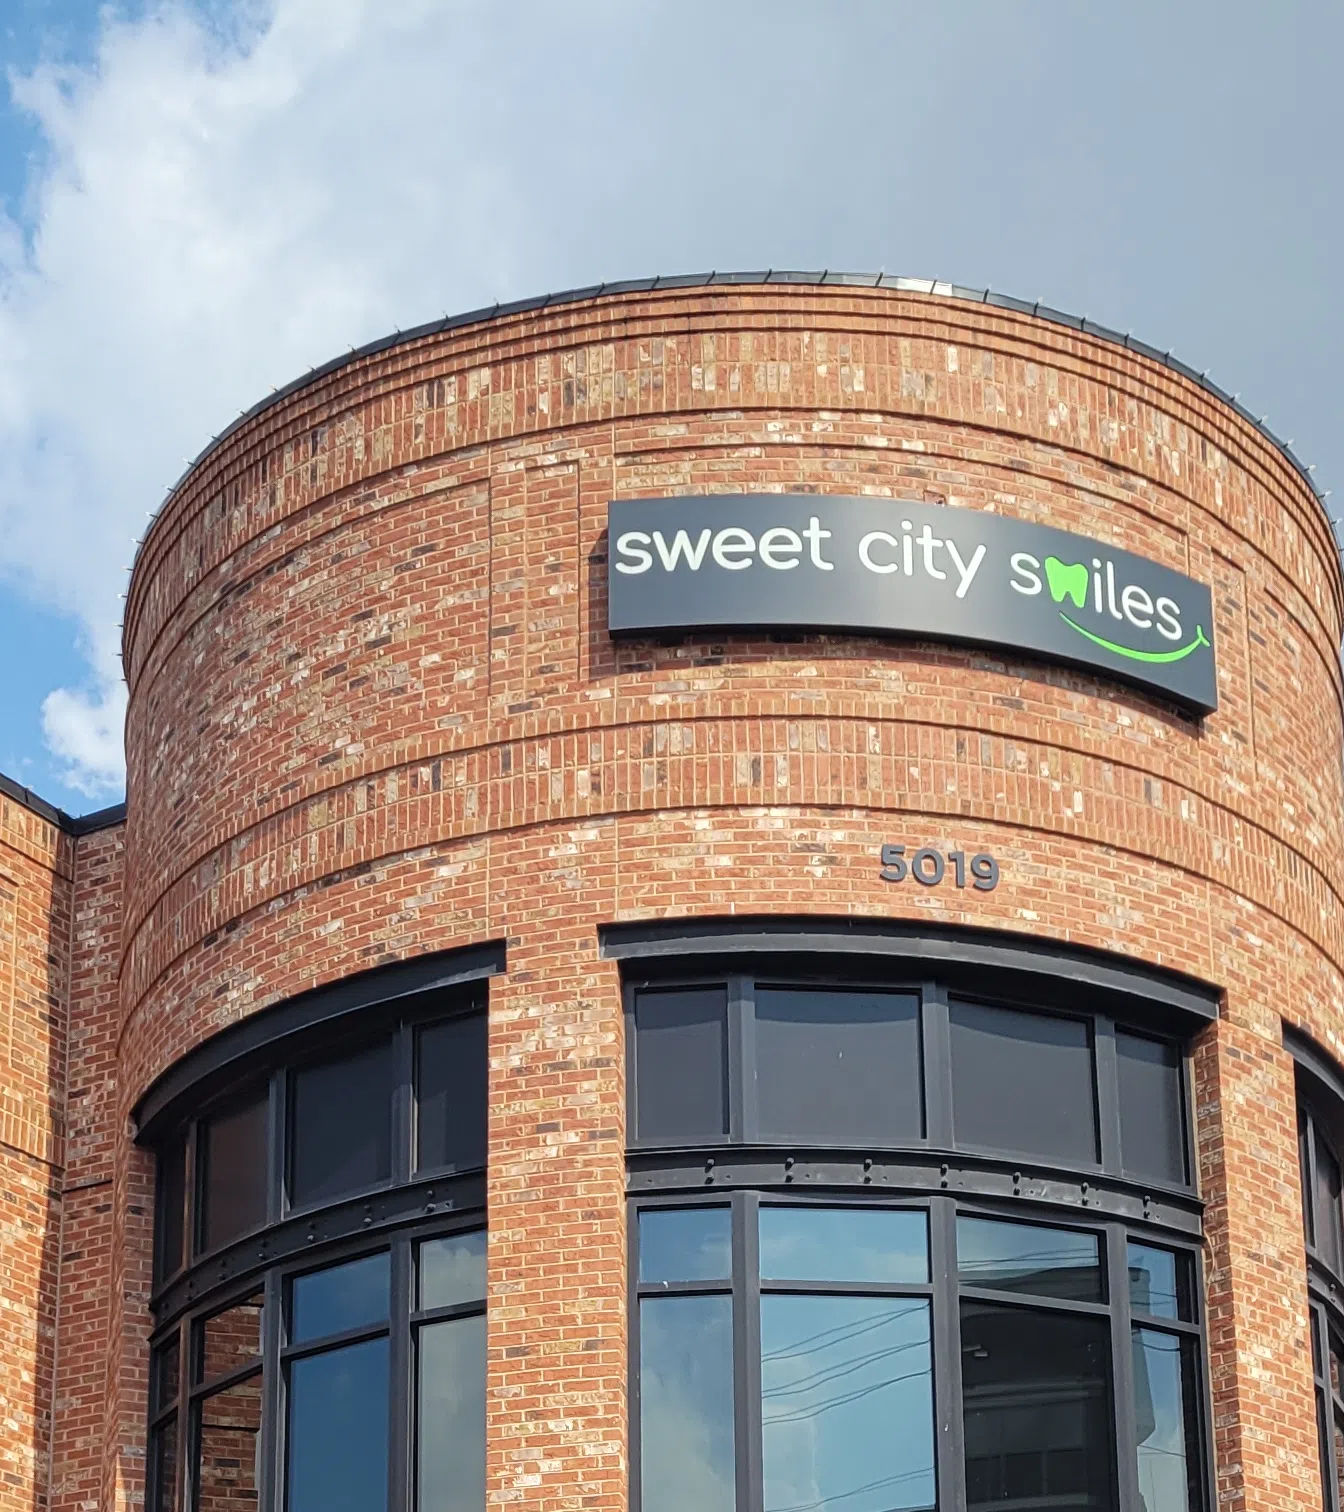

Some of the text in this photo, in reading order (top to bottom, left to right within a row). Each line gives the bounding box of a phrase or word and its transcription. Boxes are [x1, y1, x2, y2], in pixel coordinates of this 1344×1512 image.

[615, 515, 834, 575] sweet
[858, 519, 986, 598] city
[879, 843, 1000, 890] 5019
